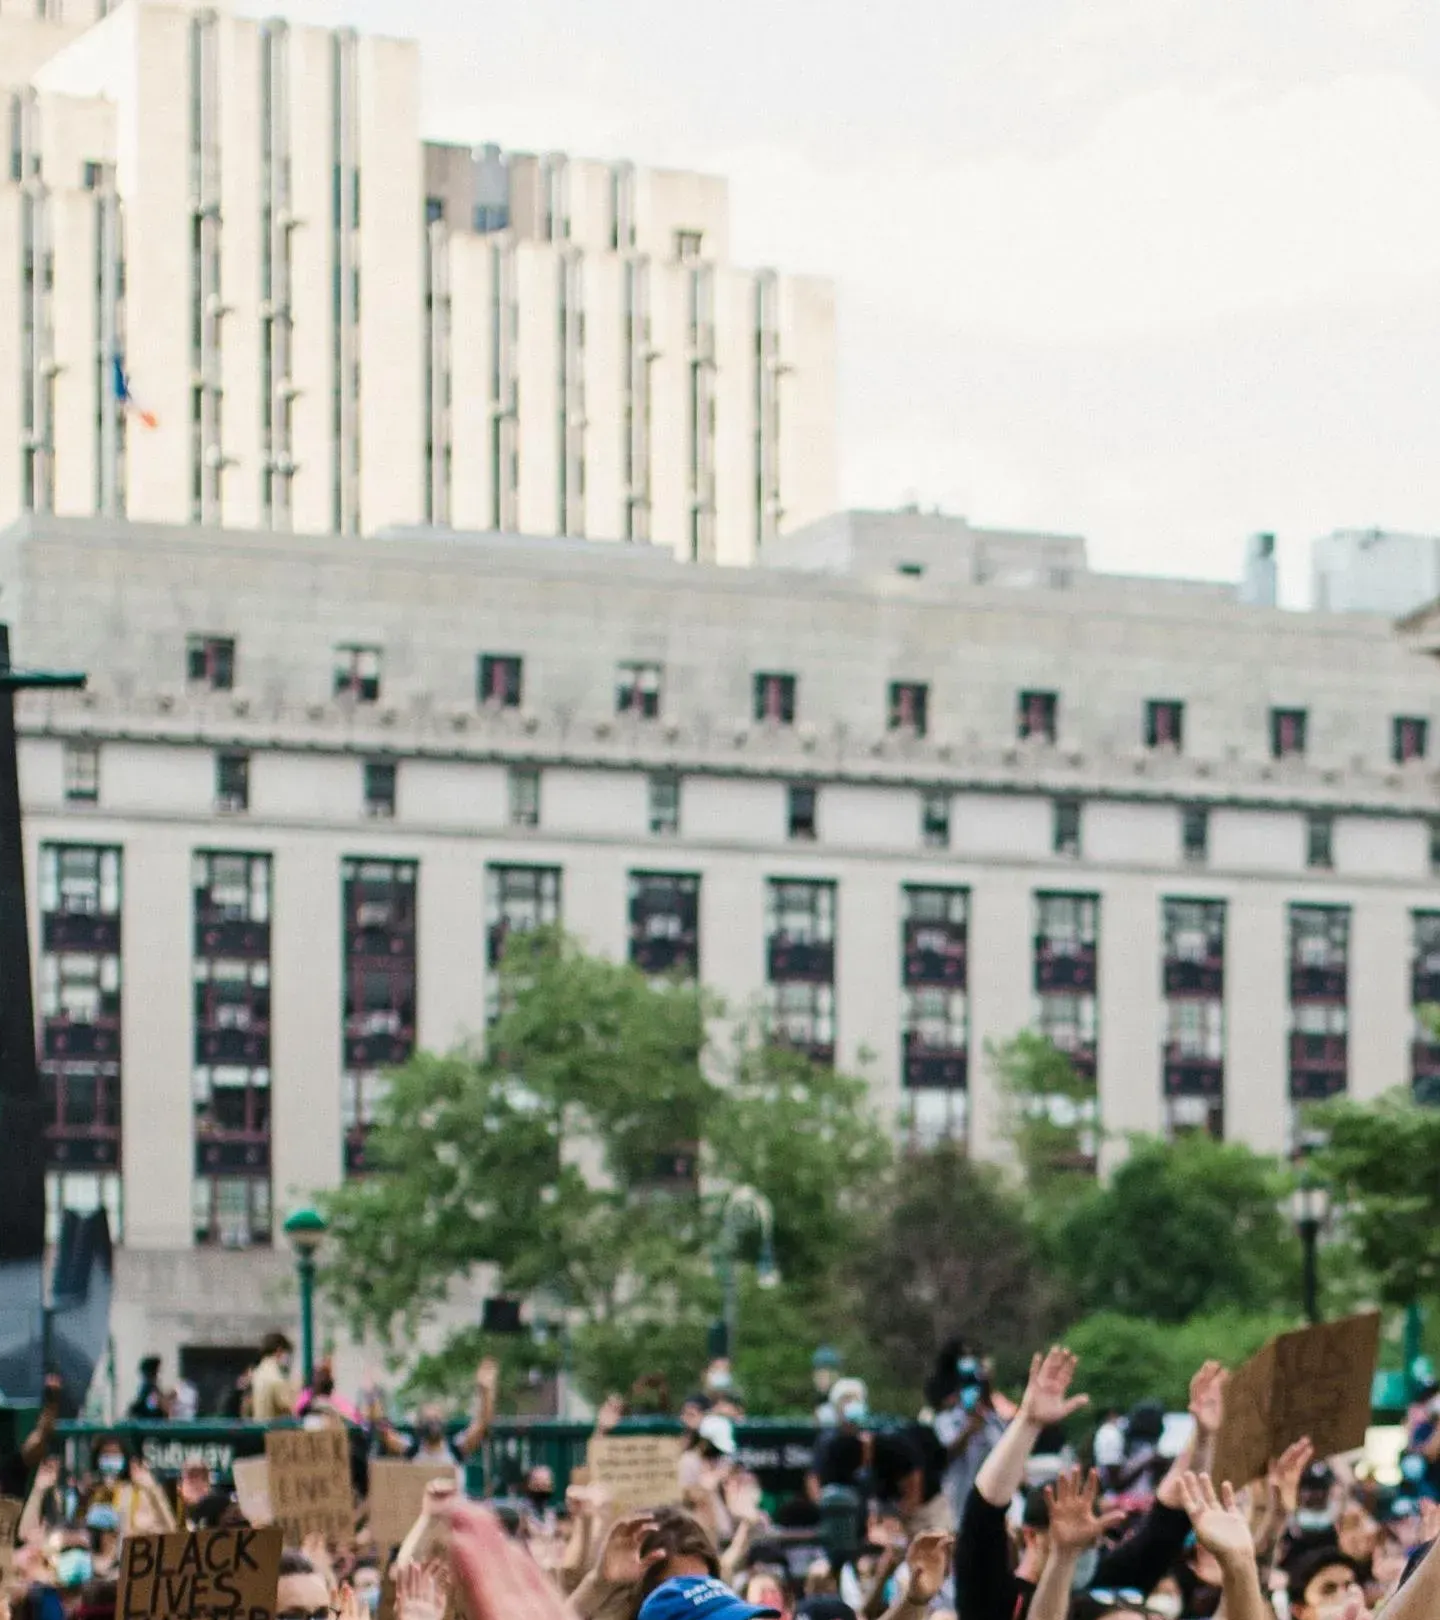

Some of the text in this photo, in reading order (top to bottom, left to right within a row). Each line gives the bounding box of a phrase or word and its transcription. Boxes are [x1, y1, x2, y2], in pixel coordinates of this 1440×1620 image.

[142, 1439, 233, 1472] Subway
[128, 1530, 259, 1579] BLACK
[124, 1571, 242, 1618] LIVES
